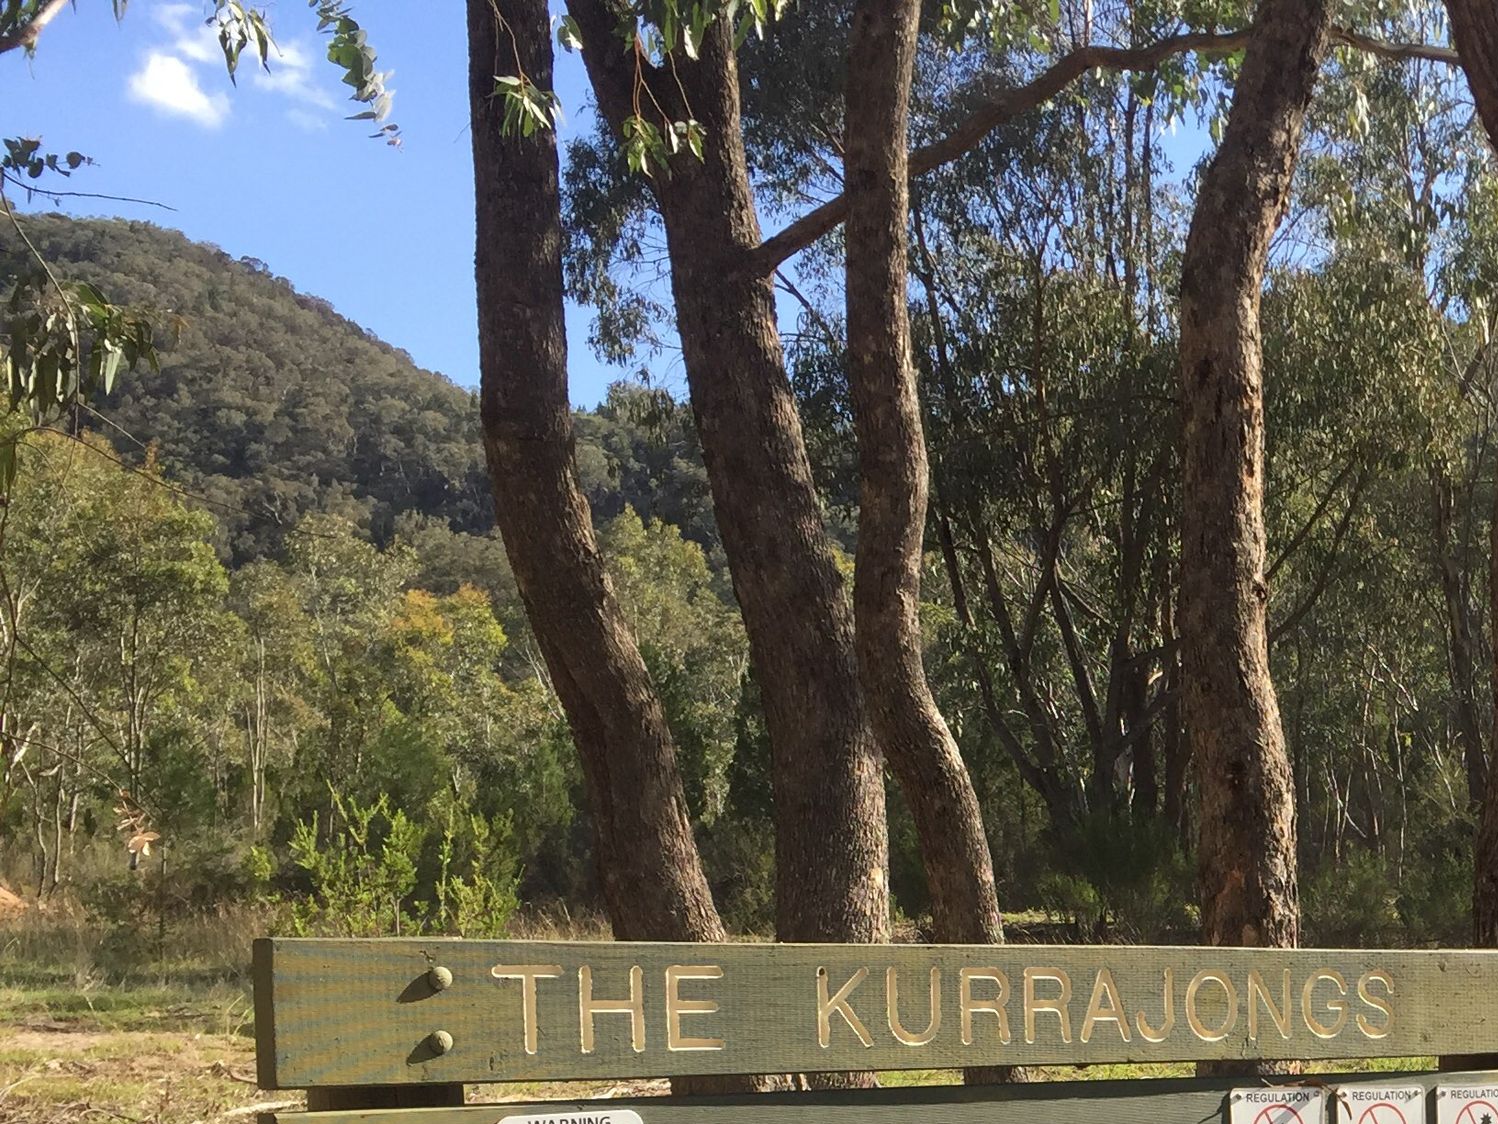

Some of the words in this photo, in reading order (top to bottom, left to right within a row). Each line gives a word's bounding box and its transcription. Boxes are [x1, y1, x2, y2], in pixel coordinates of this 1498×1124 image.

[491, 964, 726, 1054] THE
[816, 965, 1397, 1048] KURRAJONGS
[1246, 1092, 1310, 1103] REGULATION
[1352, 1090, 1412, 1101] REGULATION
